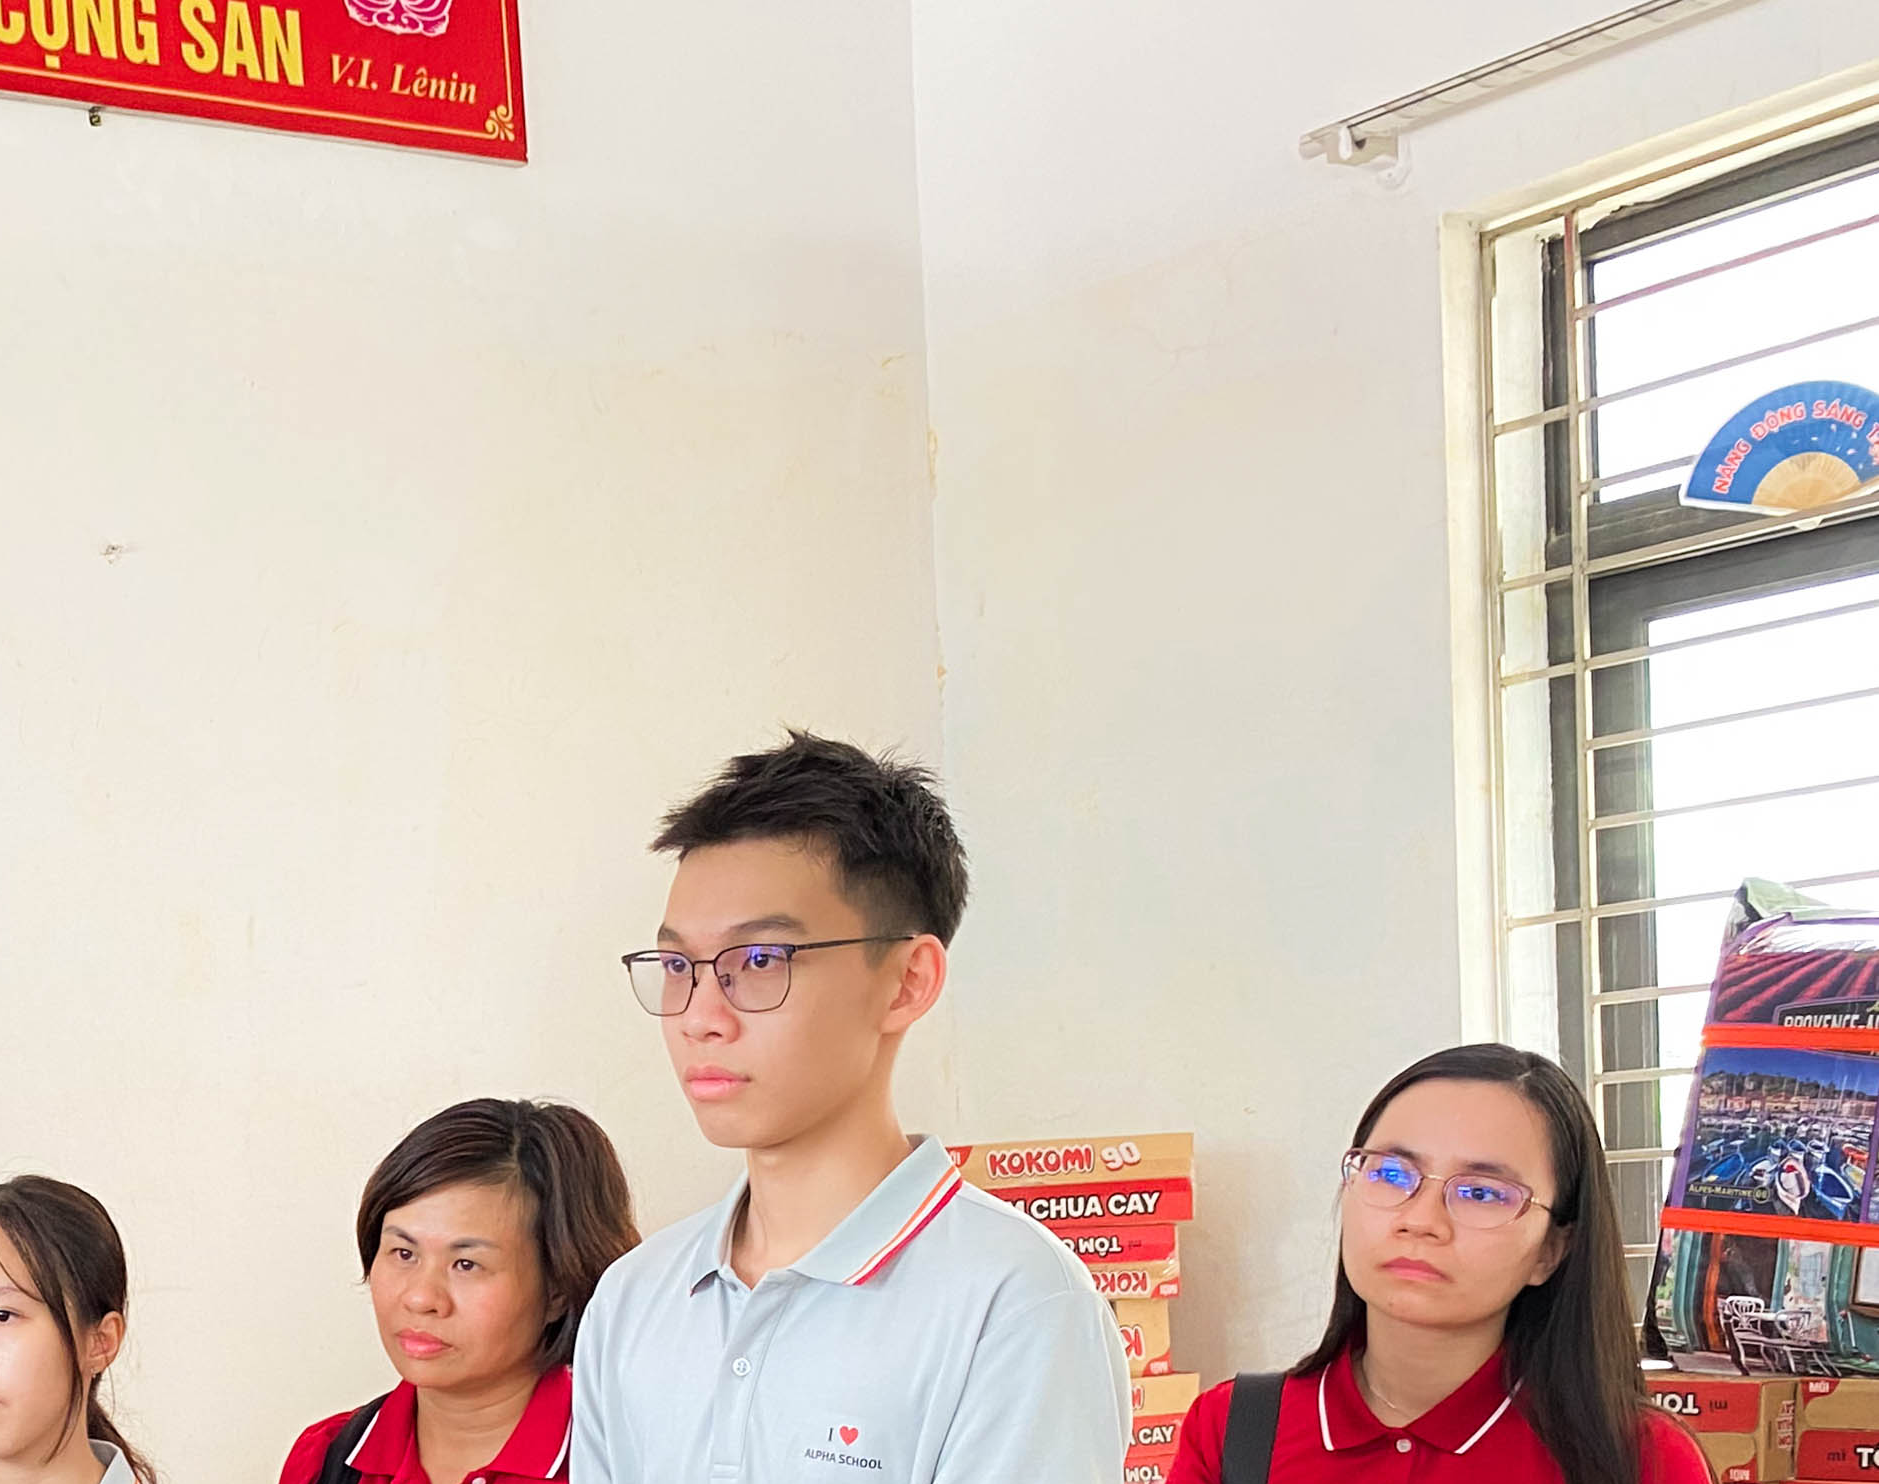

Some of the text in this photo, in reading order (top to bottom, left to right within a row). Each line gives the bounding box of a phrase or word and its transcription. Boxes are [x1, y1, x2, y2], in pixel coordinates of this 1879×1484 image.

[331, 53, 478, 105] V.I. Lênin
[1812, 398, 1868, 430] SÁNG
[987, 1142, 1141, 1178] KOKOMI 90
[1029, 1196, 1104, 1221] CHUA
[1107, 1190, 1161, 1216] CAY
[1138, 1426, 1175, 1445] CAY
[804, 1448, 883, 1470] ALPHA SCHOOL
